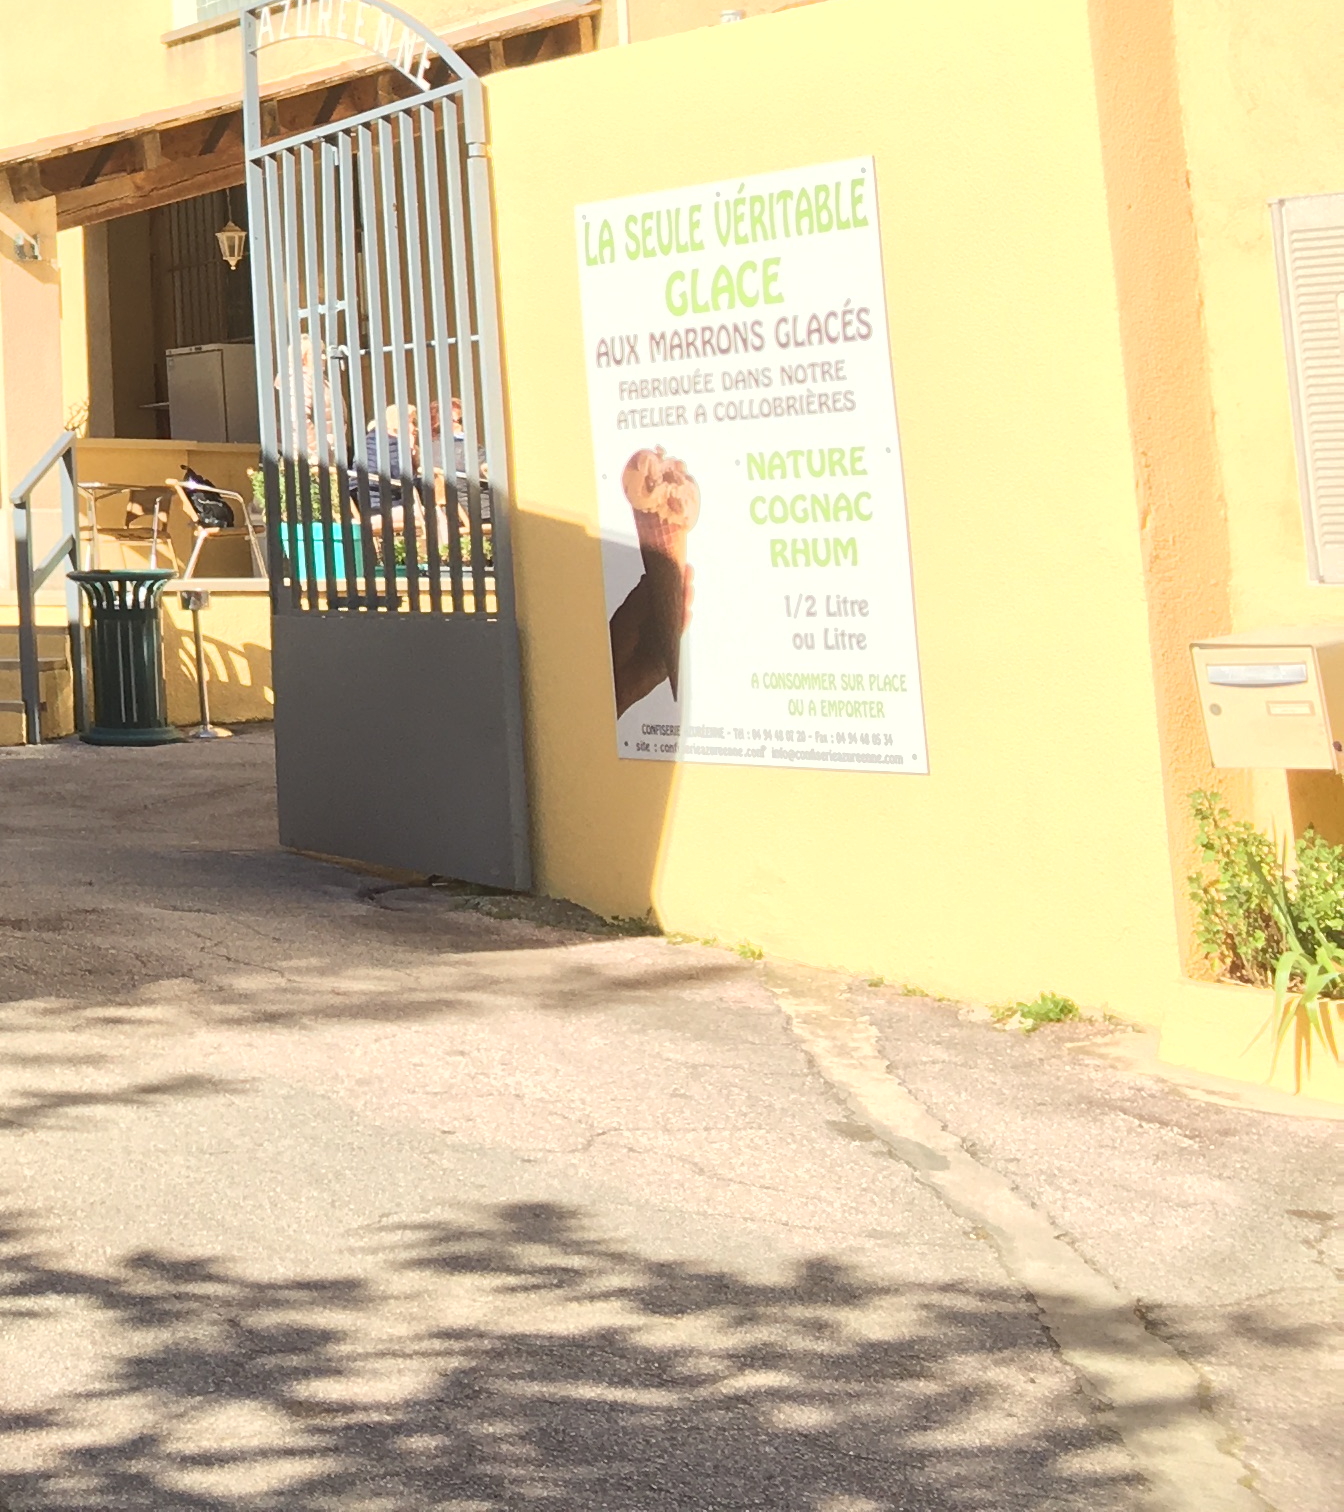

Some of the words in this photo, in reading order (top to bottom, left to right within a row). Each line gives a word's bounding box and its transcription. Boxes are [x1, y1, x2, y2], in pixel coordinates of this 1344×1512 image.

[584, 218, 616, 267] LA
[624, 204, 706, 262] SEULE
[713, 178, 870, 248] VÉRITABLE
[665, 257, 785, 317] GLACE
[595, 334, 641, 368] AUX
[648, 319, 766, 363] MARRONS
[774, 298, 874, 350] GLACÉS
[618, 368, 715, 401] FABRIQUÉE
[721, 367, 773, 392] DANS
[779, 359, 848, 386] NOTRE
[616, 405, 689, 430] ATELIER
[694, 403, 709, 424] A
[713, 388, 857, 423] COLLOBRIÈRES
[746, 446, 868, 480] NATURE
[749, 491, 873, 525] COGNAC
[770, 537, 858, 568] RHUM
[784, 593, 817, 619] 1/2
[825, 594, 870, 618] Litre
[792, 632, 816, 651] ou
[824, 628, 867, 651] Litre
[750, 672, 760, 690] A
[762, 672, 838, 691] CONSOMMER
[840, 673, 866, 692] SUR
[868, 673, 908, 693] PLACE
[787, 699, 804, 717] OU
[808, 699, 817, 717] A
[820, 699, 886, 719] EMPORTER
